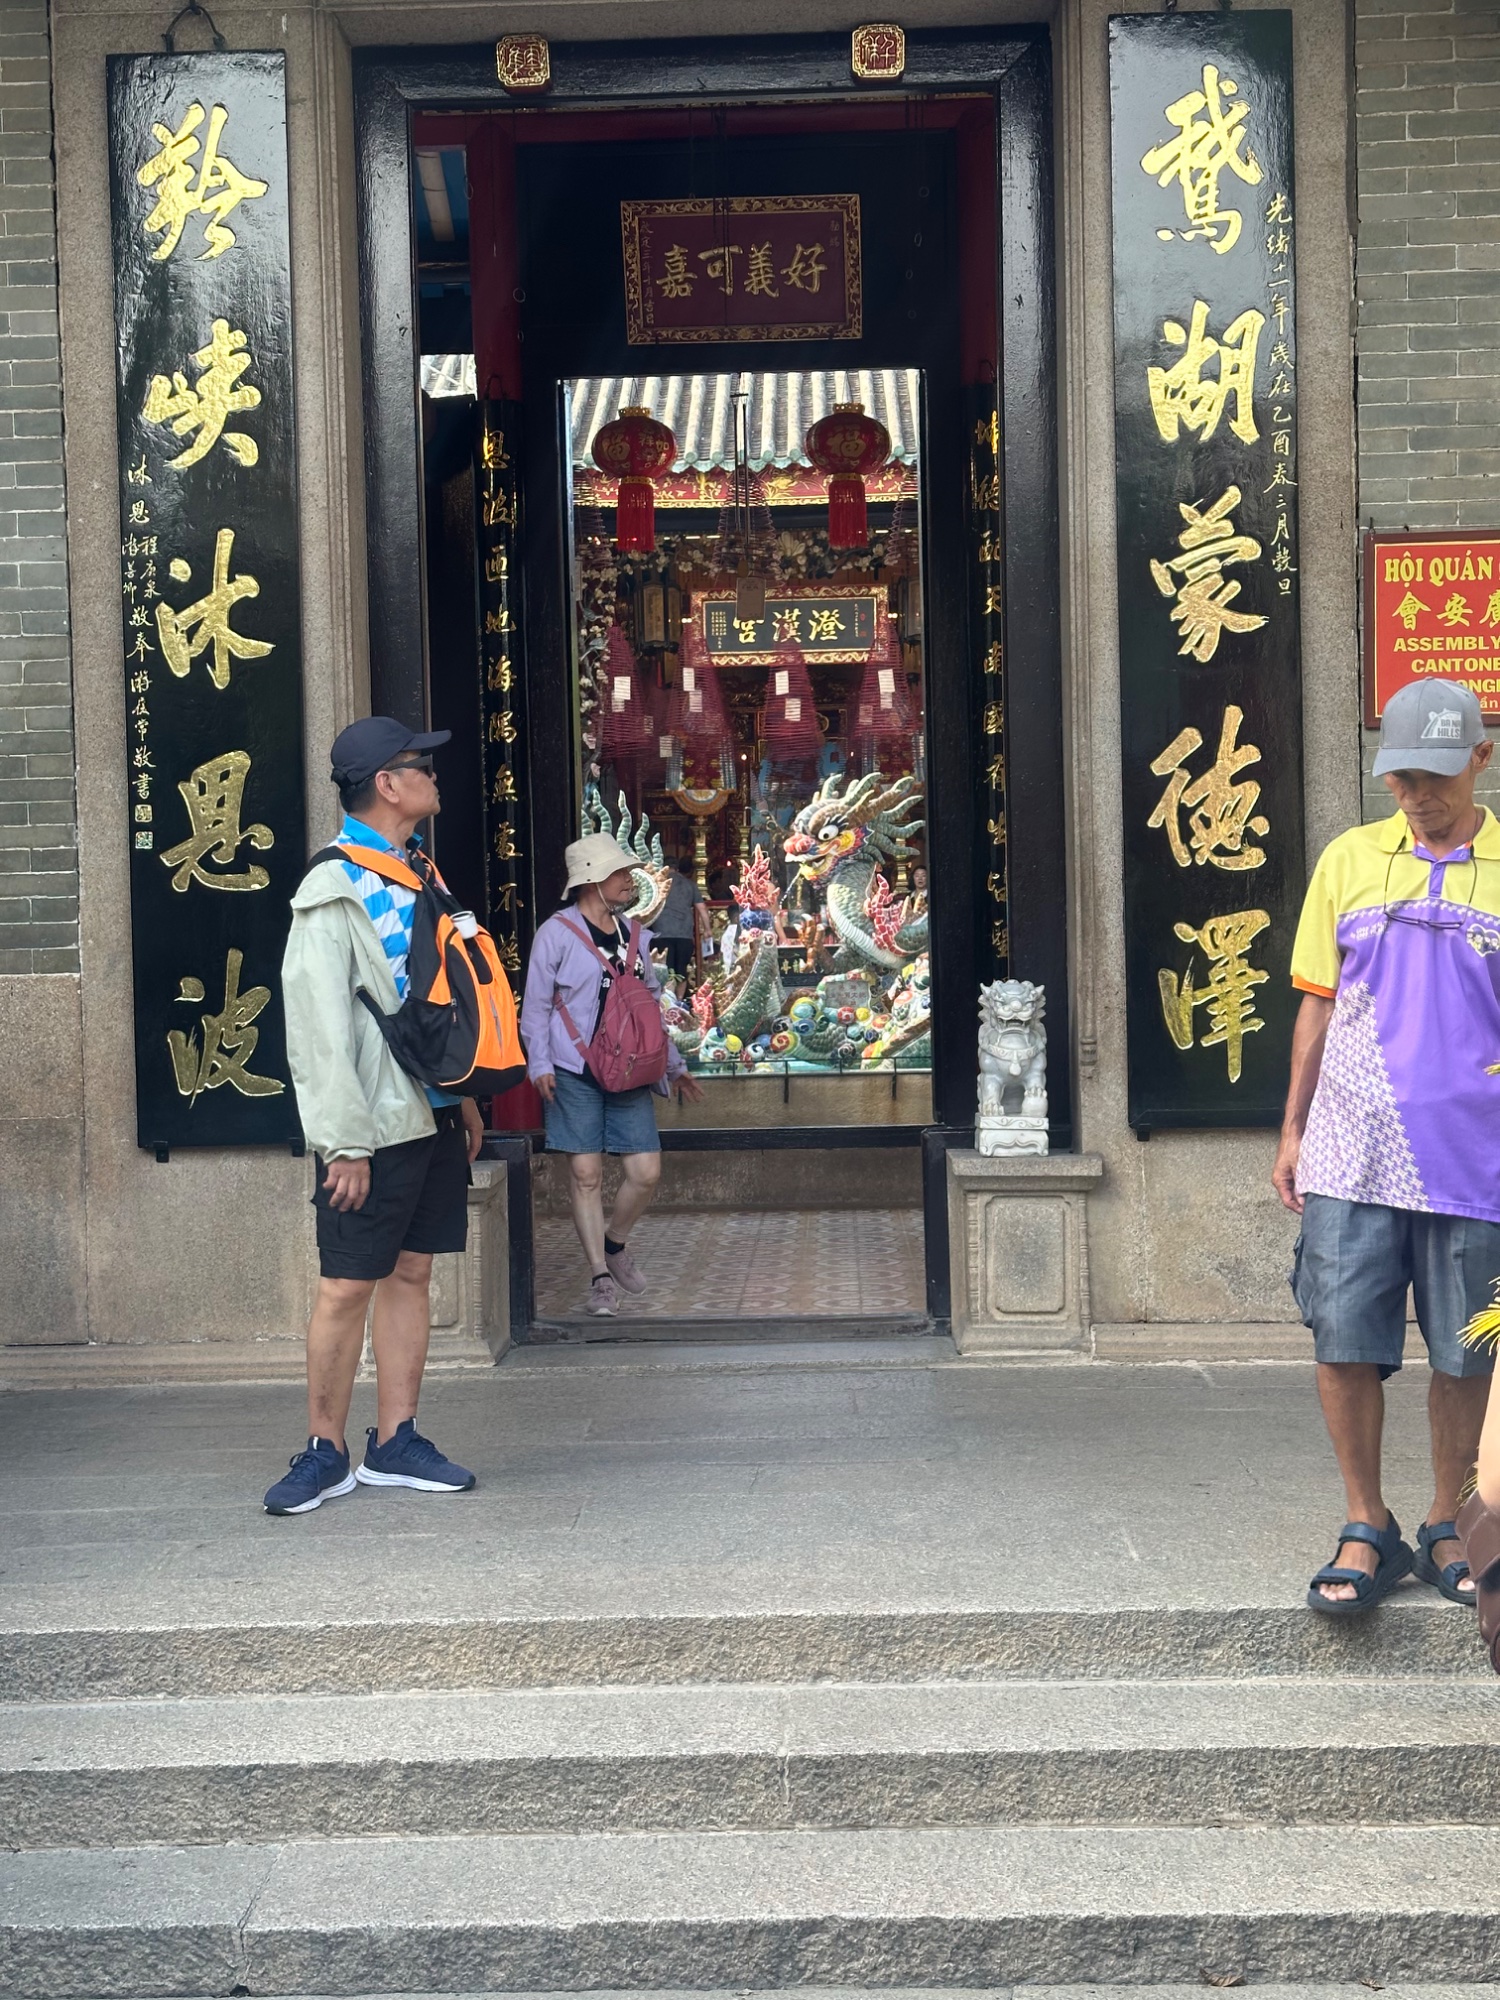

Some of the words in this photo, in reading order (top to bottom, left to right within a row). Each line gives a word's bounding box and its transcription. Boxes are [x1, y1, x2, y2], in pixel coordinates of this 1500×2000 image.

[1384, 551, 1424, 587] HỘI
[1429, 550, 1493, 586] QUÁN
[1438, 727, 1460, 738] HILLS
